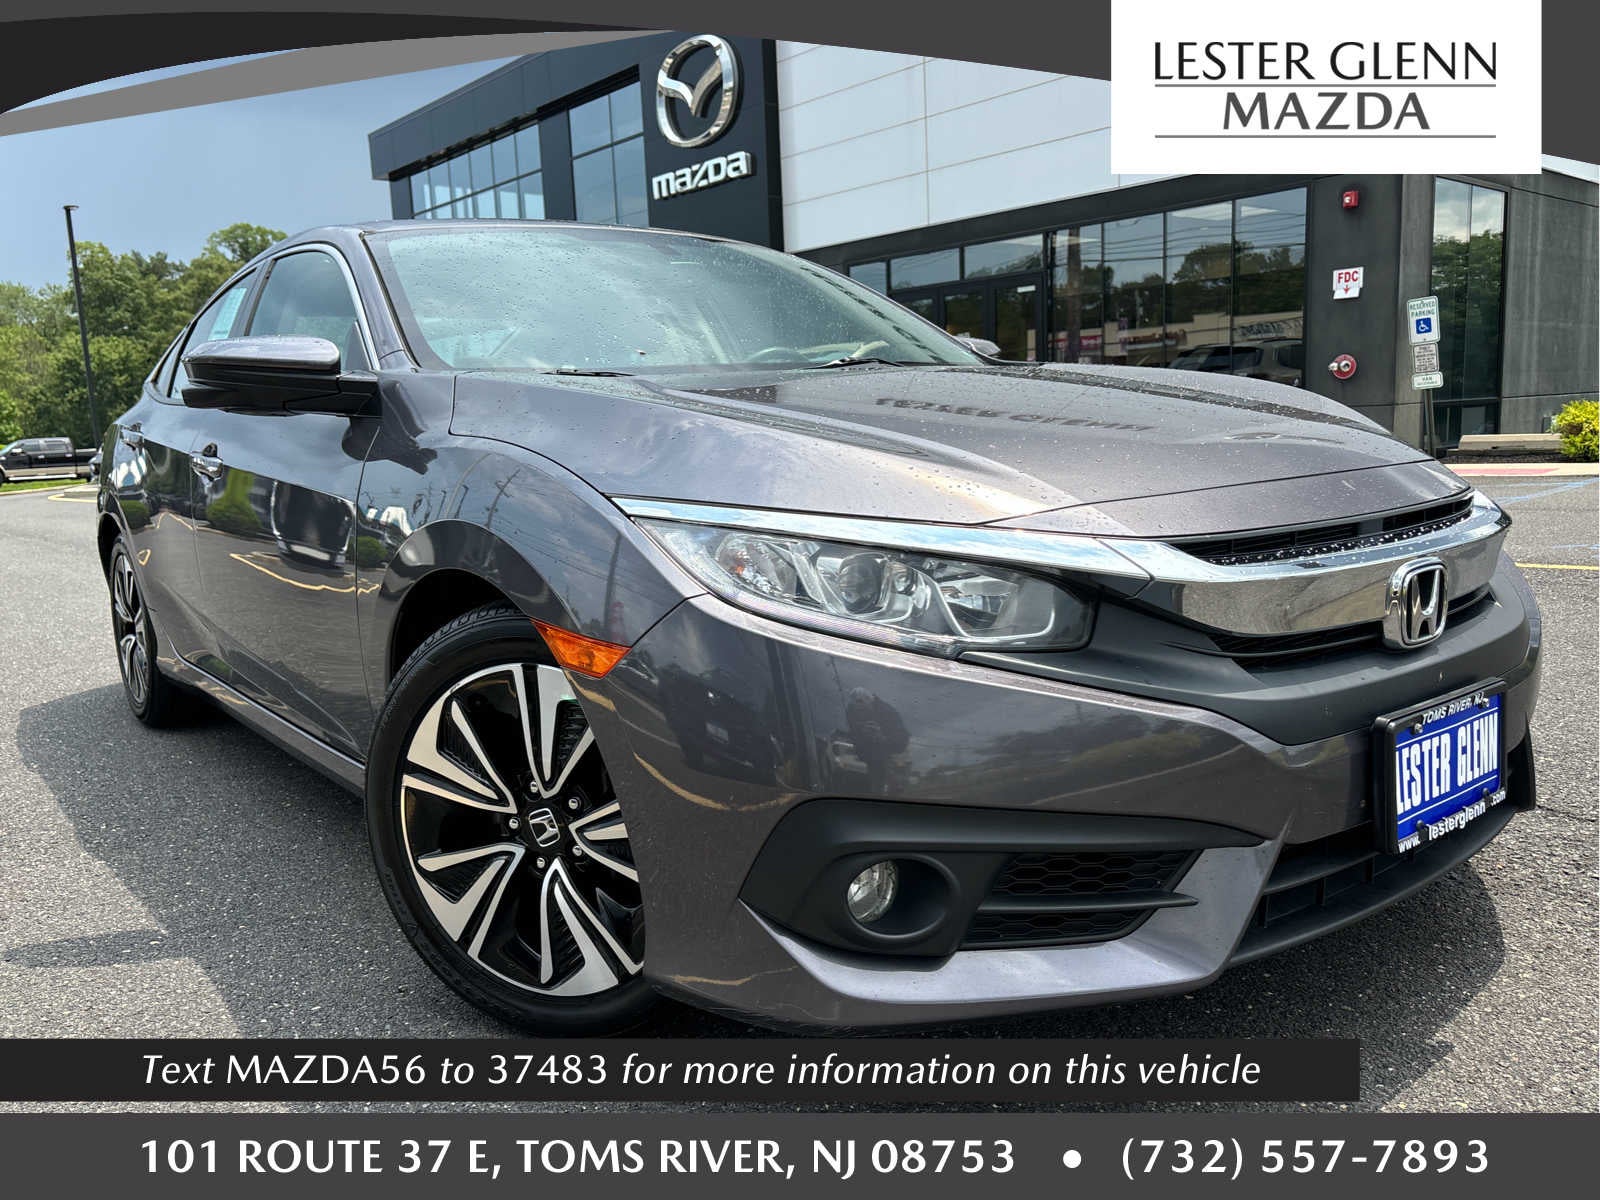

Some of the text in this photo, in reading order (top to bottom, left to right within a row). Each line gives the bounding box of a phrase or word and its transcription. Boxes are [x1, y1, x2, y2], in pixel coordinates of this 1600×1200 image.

[1338, 270, 1358, 284] FDC
[1411, 309, 1435, 317] PARKING
[1422, 705, 1446, 725] TOMS
[1396, 712, 1498, 816] LESTER GLENN
